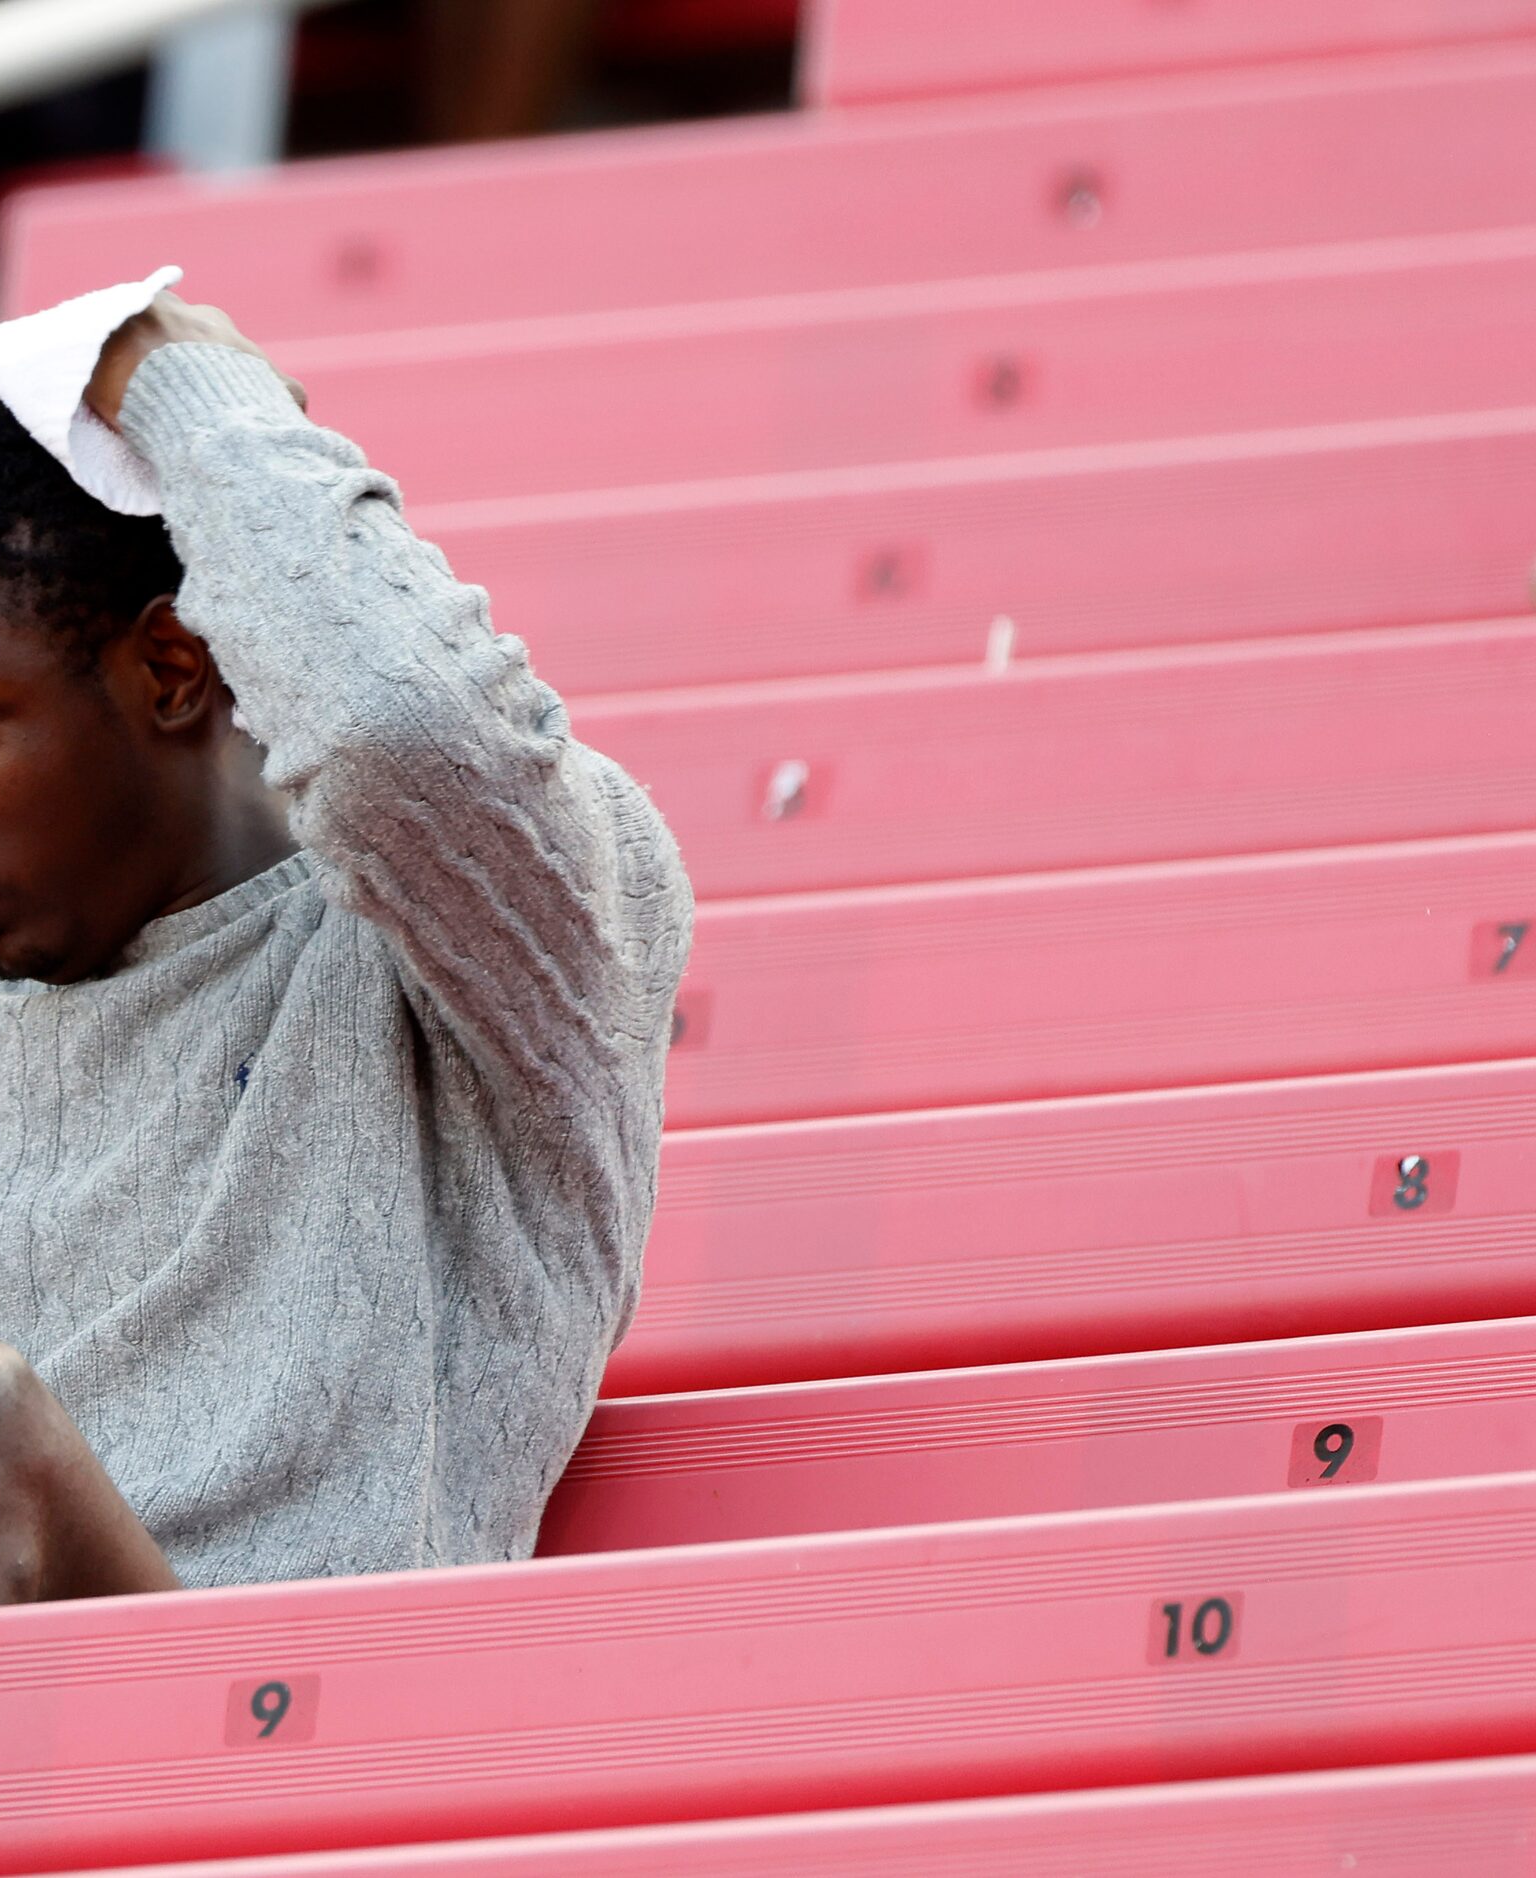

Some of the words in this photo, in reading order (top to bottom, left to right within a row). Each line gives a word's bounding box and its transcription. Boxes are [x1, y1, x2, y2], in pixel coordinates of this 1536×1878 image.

[1492, 920, 1529, 976] 7
[1394, 1154, 1430, 1209] 8
[1314, 1423, 1354, 1479] 9
[1162, 1597, 1232, 1658] 10
[250, 1681, 291, 1738] 9
